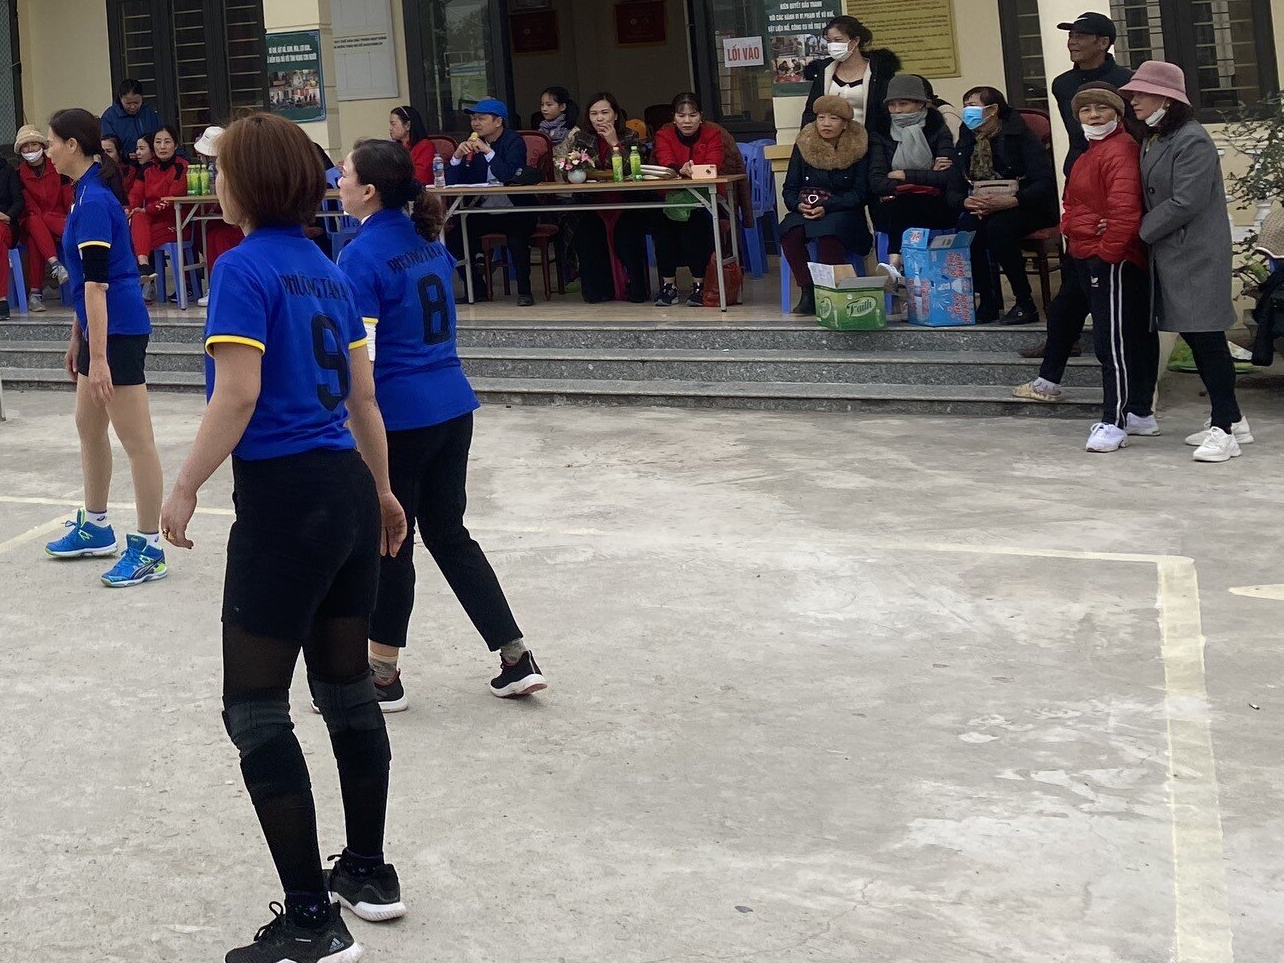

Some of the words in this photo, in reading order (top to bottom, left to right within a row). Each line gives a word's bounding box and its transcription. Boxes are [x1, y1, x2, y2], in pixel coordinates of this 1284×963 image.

[727, 43, 741, 61] LỐI
[742, 44, 760, 61] VÀO
[418, 273, 452, 346] 8
[311, 310, 350, 412] 9
